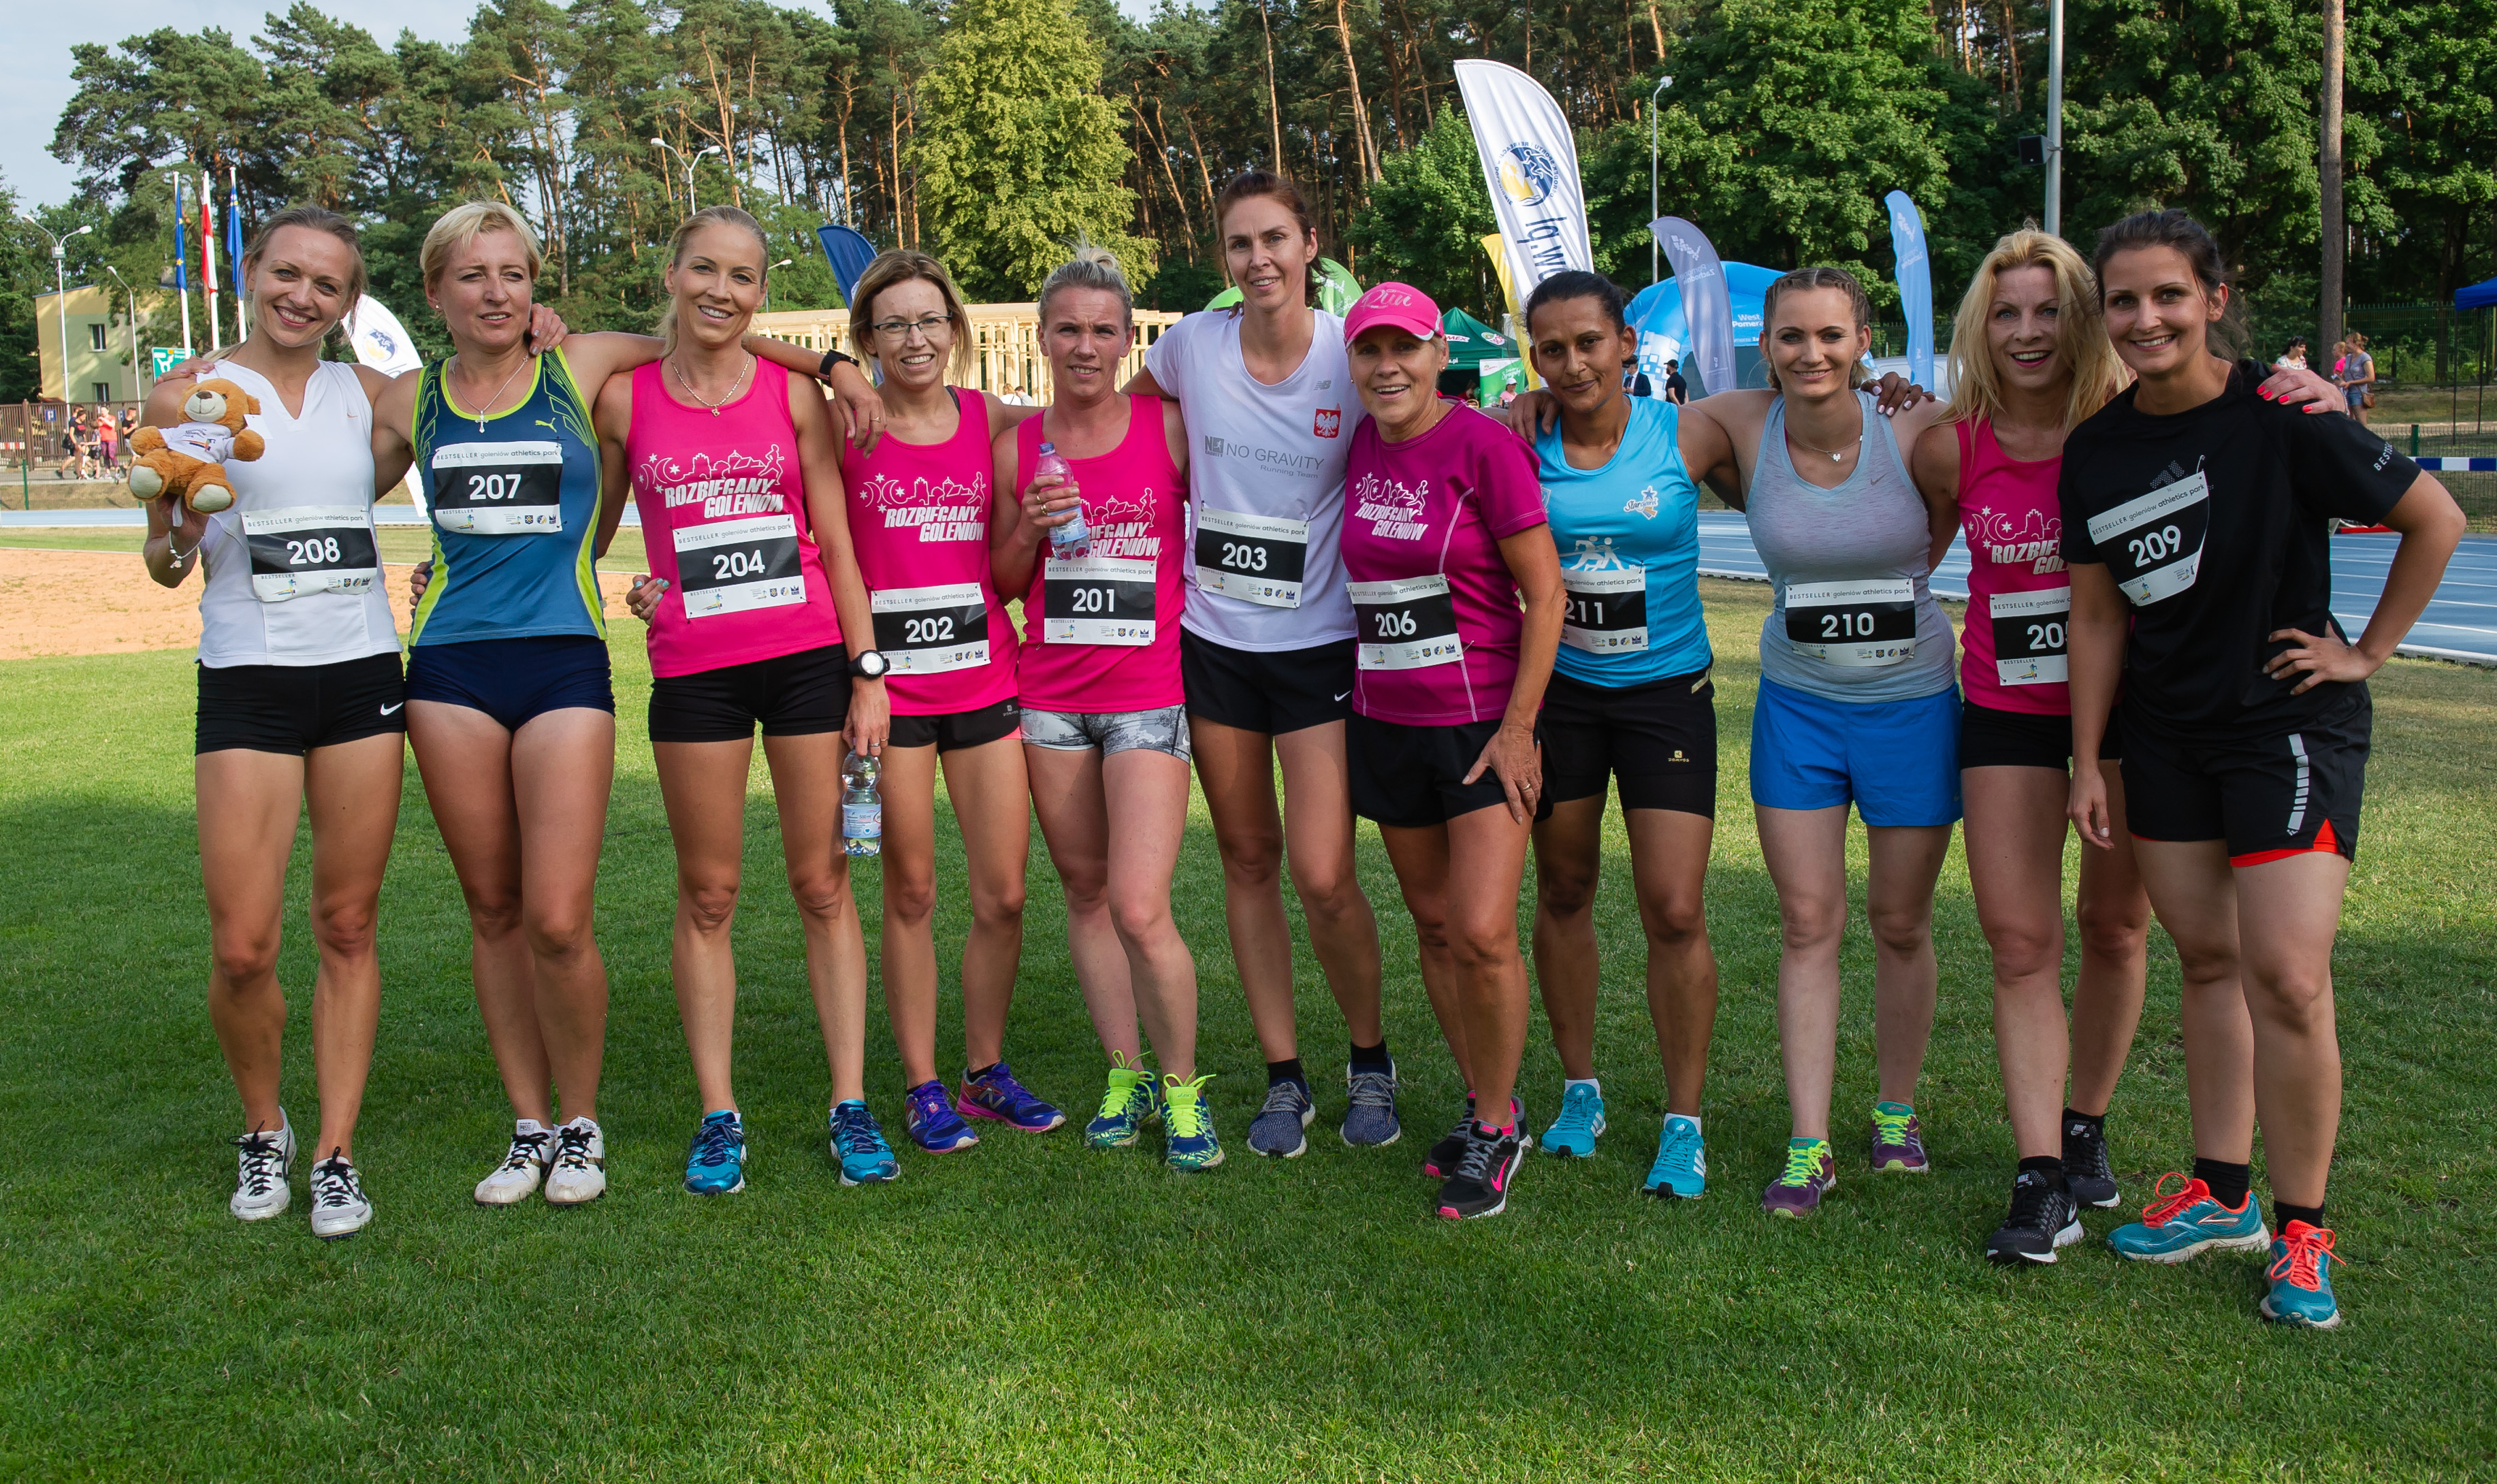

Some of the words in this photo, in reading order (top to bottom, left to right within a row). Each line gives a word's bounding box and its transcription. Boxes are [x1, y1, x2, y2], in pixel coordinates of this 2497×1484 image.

[436, 452, 478, 460] BESTSELLER
[480, 450, 509, 459] goleniów
[543, 450, 558, 458] park
[1226, 442, 1249, 458] NO
[1255, 449, 1325, 470] GRAVITY
[1260, 465, 1294, 477] Running
[1297, 470, 1319, 479] Team
[468, 474, 521, 500] 207
[704, 491, 784, 519] GOLENIÓW
[2092, 516, 2127, 536] BESTSELLER
[2129, 503, 2157, 521] goleniów
[2158, 491, 2188, 508] athletics
[2189, 483, 2205, 496] park
[247, 517, 293, 528] BESTSELLER
[295, 515, 323, 524] goleniów
[678, 532, 719, 544] BESTSELLER
[721, 528, 748, 538] goleniów
[750, 524, 776, 534] athletics
[778, 522, 792, 532] park
[919, 519, 984, 542] GOLENIÓW
[1202, 516, 1234, 527] BESTSELLER
[1235, 522, 1261, 531] goleniów
[1262, 525, 1289, 534] athletics
[1291, 528, 1305, 536] park
[1372, 519, 1428, 541] GOLENIÓW
[287, 537, 340, 564] 208
[1090, 534, 1161, 558] GOLENIÓW
[1221, 543, 1267, 571] 203
[2129, 525, 2181, 568] 209
[713, 549, 765, 580] 204
[914, 595, 940, 604] goleniów
[1399, 584, 1428, 594] athletics
[1430, 581, 1445, 590] park
[1833, 590, 1861, 598] goleniów
[1072, 588, 1115, 613] 201
[1564, 600, 1603, 624] 211
[1993, 602, 2033, 610] BESTSELLER
[2035, 598, 2065, 609] goleniów
[905, 616, 954, 643] 202
[1375, 610, 1417, 636] 206
[1820, 613, 1874, 638] 210
[2027, 623, 2068, 650] 20
